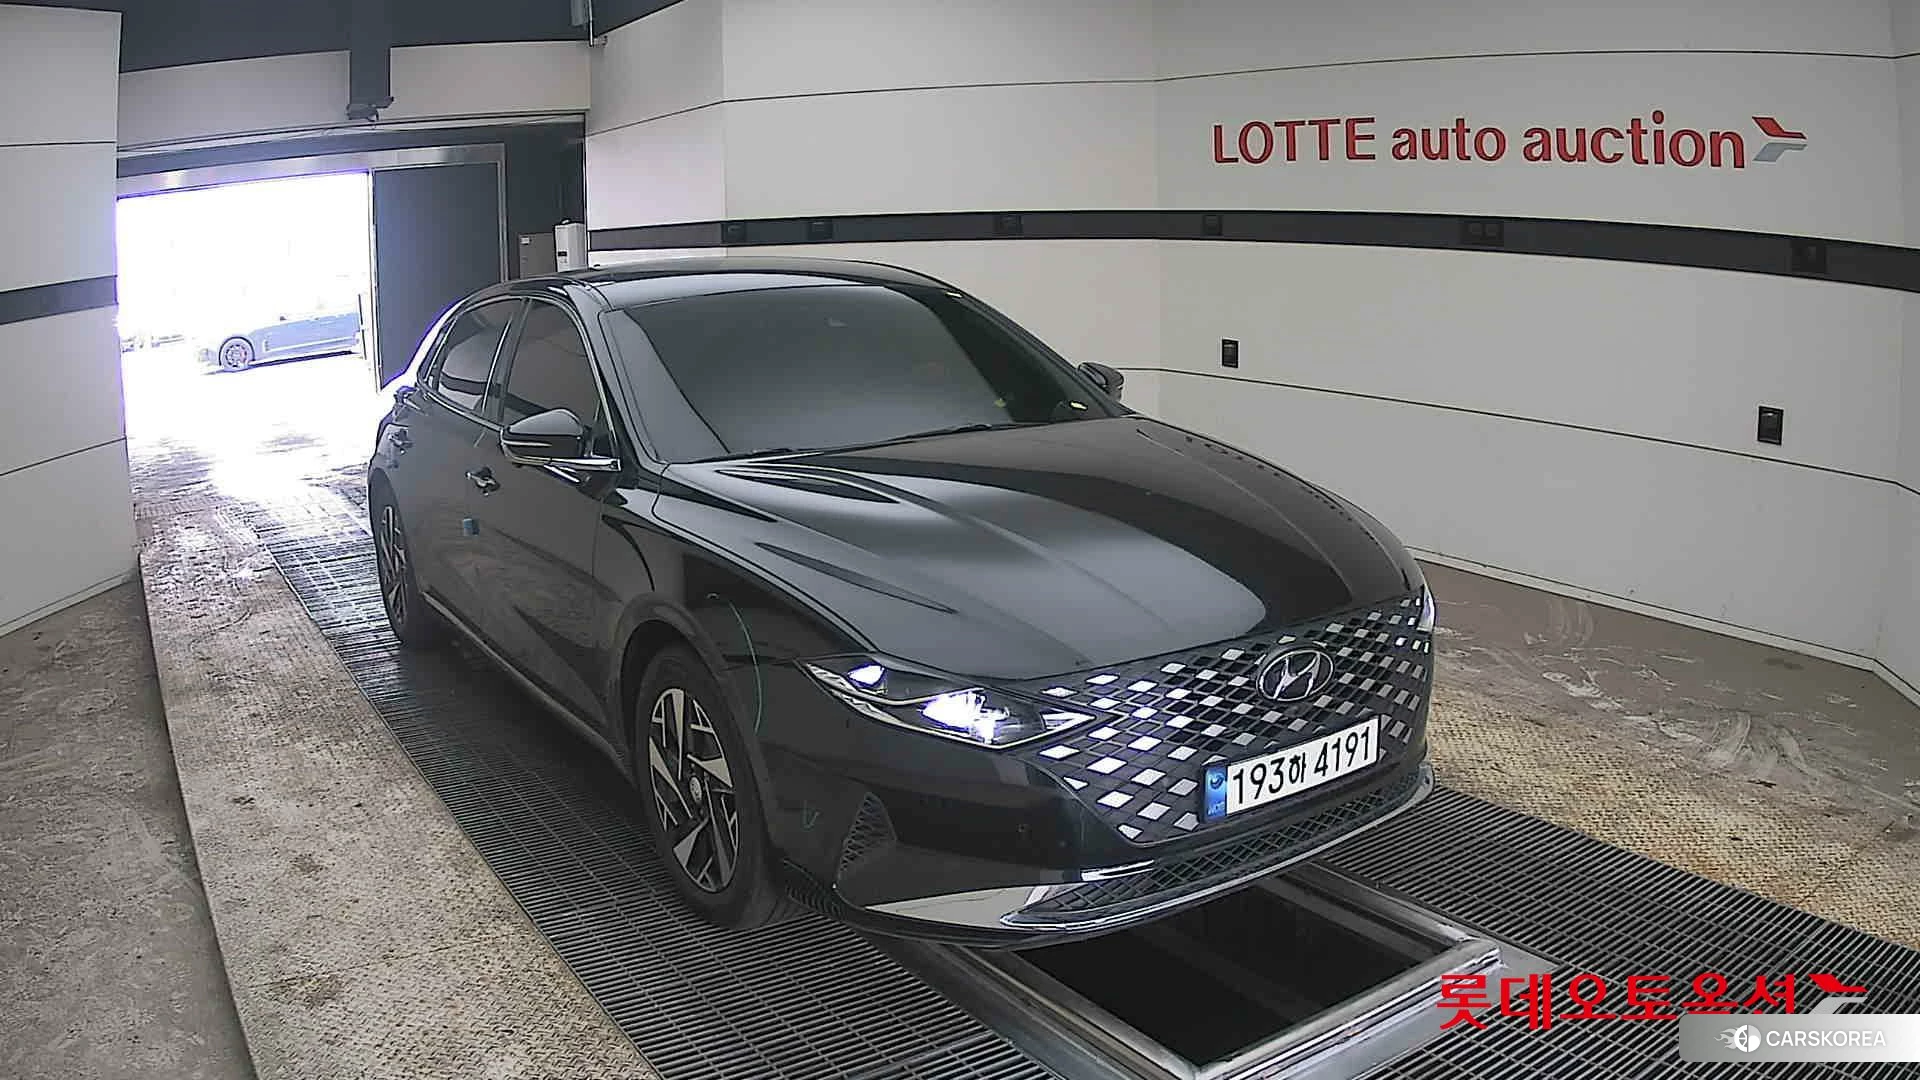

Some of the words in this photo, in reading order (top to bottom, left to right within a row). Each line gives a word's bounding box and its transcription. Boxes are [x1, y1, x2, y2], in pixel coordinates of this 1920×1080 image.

[1213, 116, 1376, 164] LOTTE
[1391, 117, 1507, 162] auto
[1522, 110, 1746, 169] auction
[1232, 751, 1307, 805] 193하
[1313, 725, 1370, 777] 4191
